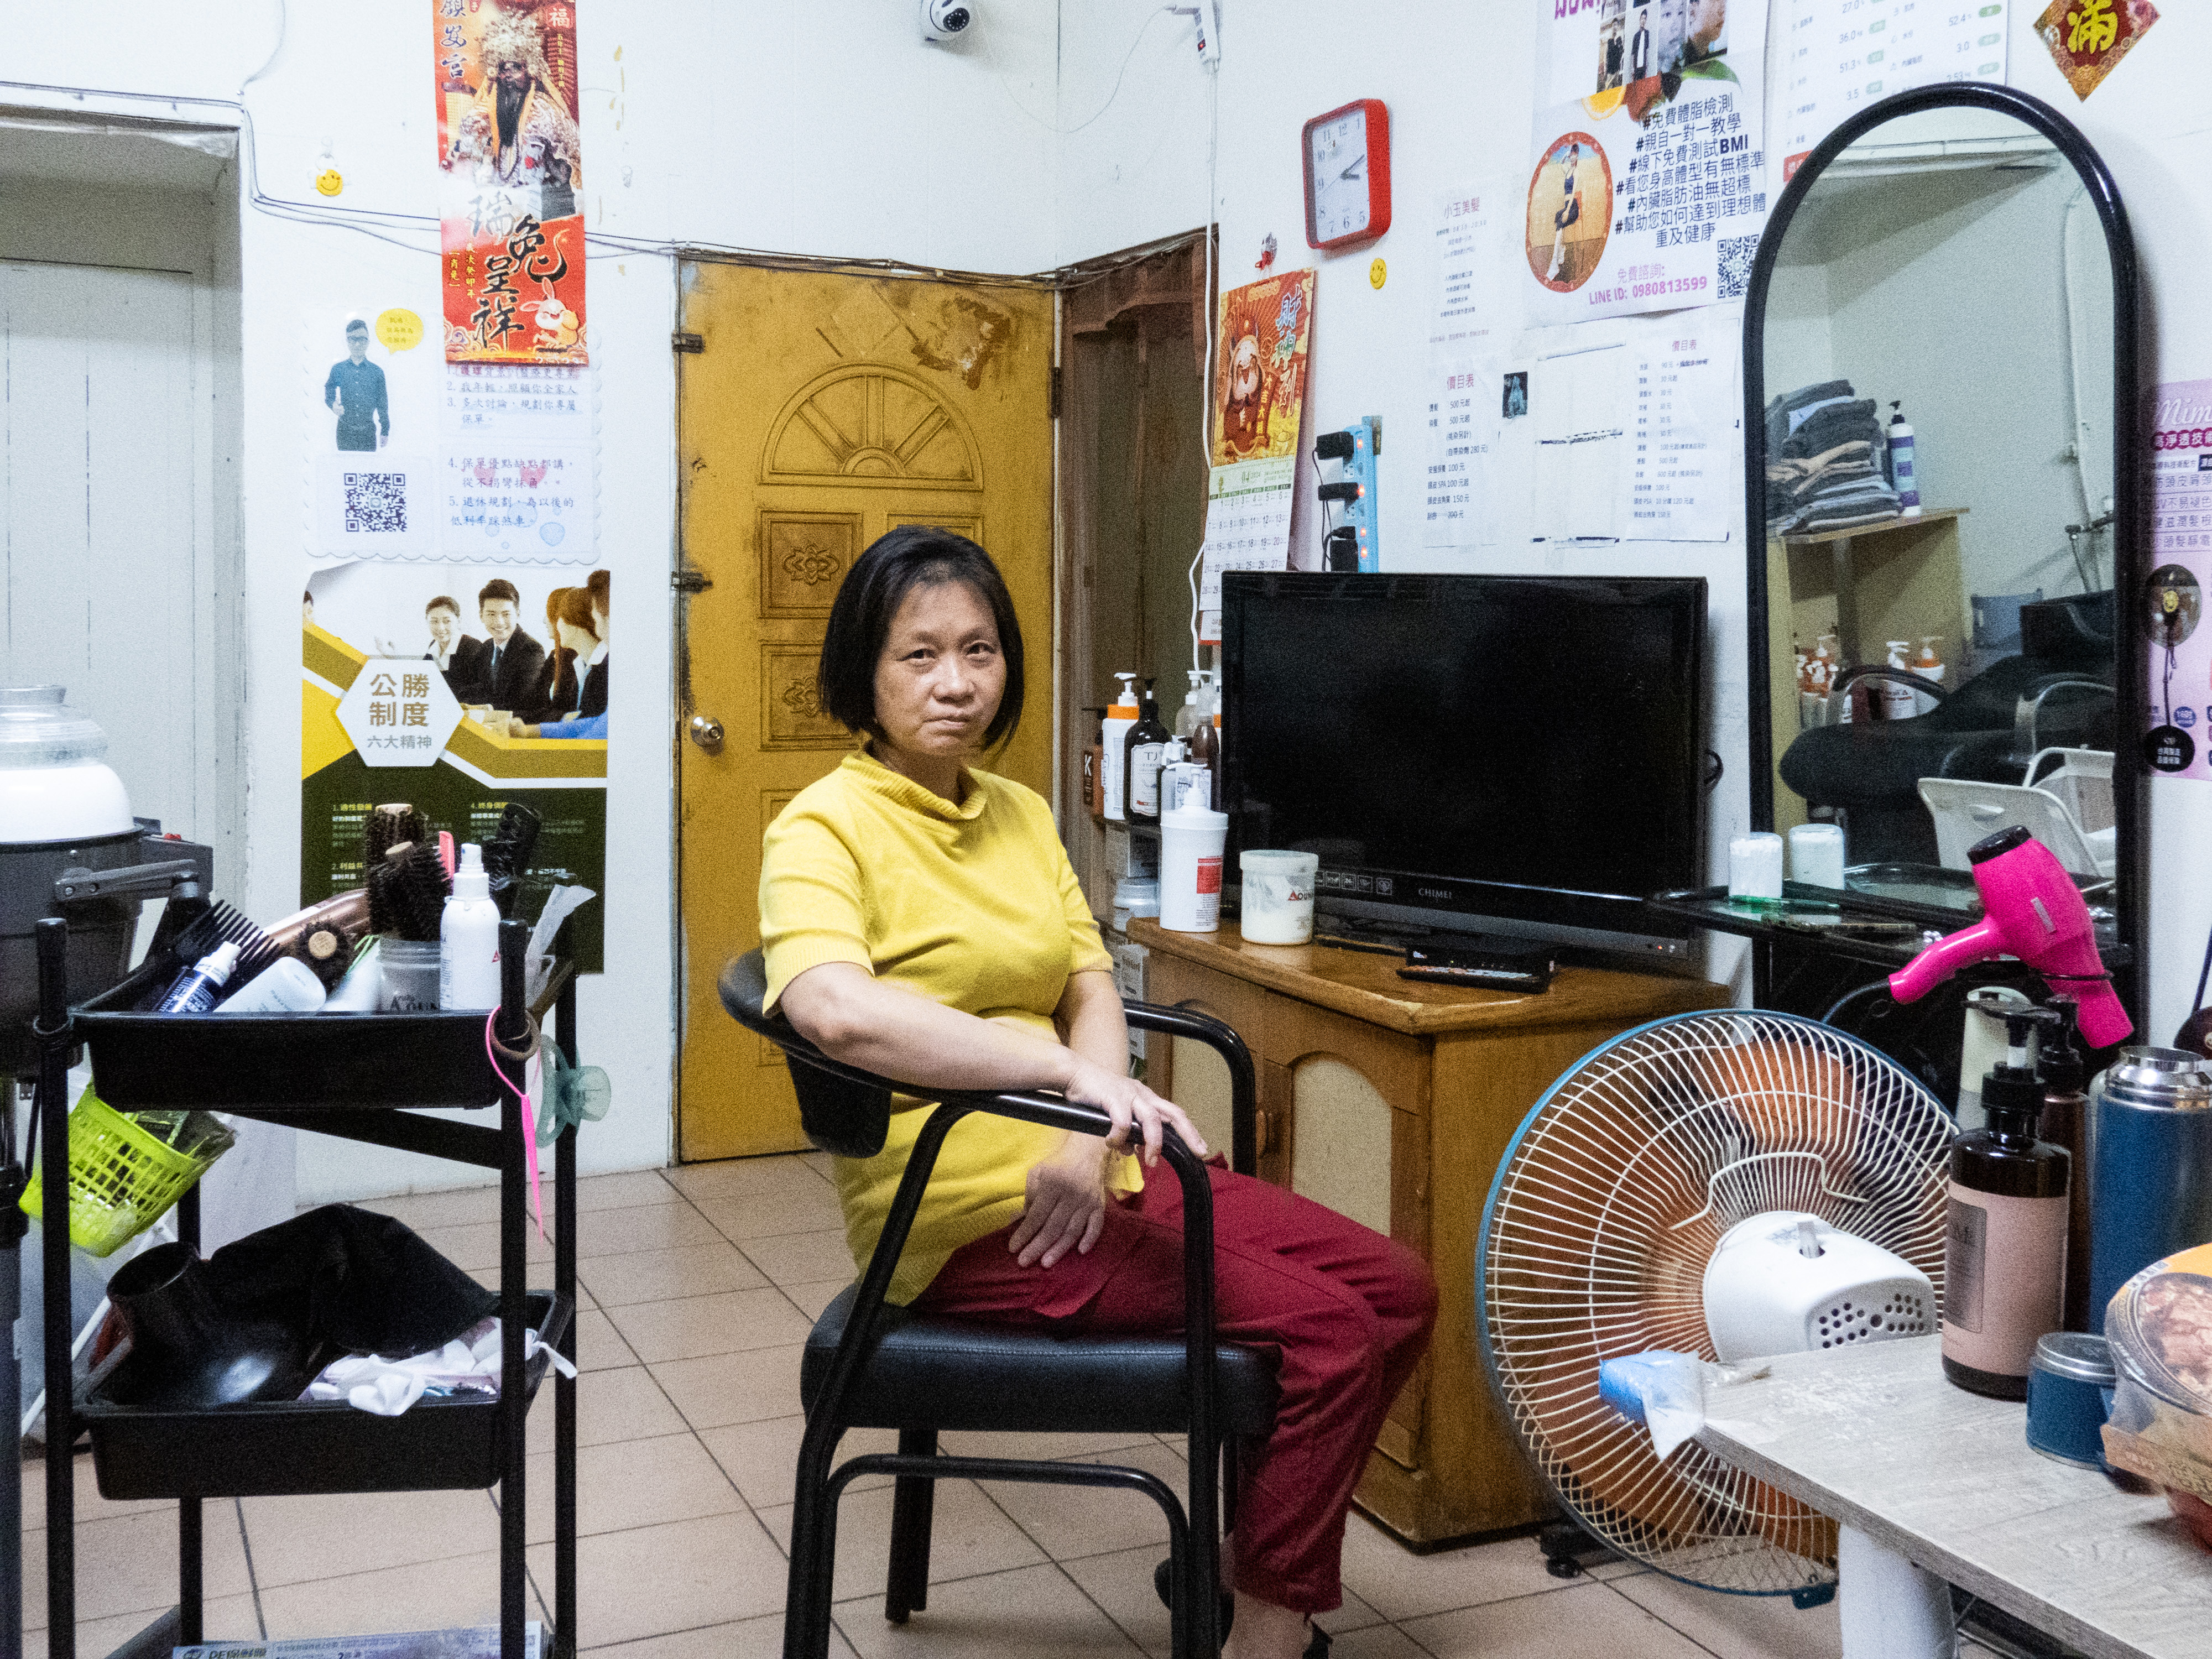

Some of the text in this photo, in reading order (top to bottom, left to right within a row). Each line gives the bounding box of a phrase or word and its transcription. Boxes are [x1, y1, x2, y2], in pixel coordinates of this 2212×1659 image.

[548, 7, 571, 28] 福
[1642, 92, 1733, 131] #免費體脂檢測
[1338, 123, 1347, 137] 12
[1636, 113, 1741, 152] #親自一對一教學
[1629, 134, 1749, 173] #線下免費測試BMI
[1616, 150, 1764, 195] #看您身高體型有無標準
[1343, 216, 1350, 229] 6
[1615, 192, 1766, 234] #幫助您如何達到理想體
[1656, 222, 1715, 248] 重及健康
[1589, 275, 1708, 305] LINE ID: 0980813599
[1672, 339, 1697, 352] 價目表
[1447, 373, 1474, 391] 價目表
[369, 673, 430, 698] 公勝
[368, 701, 430, 728] 制度
[367, 735, 432, 749] 六大精神
[1418, 888, 1453, 899] CHIMEI
